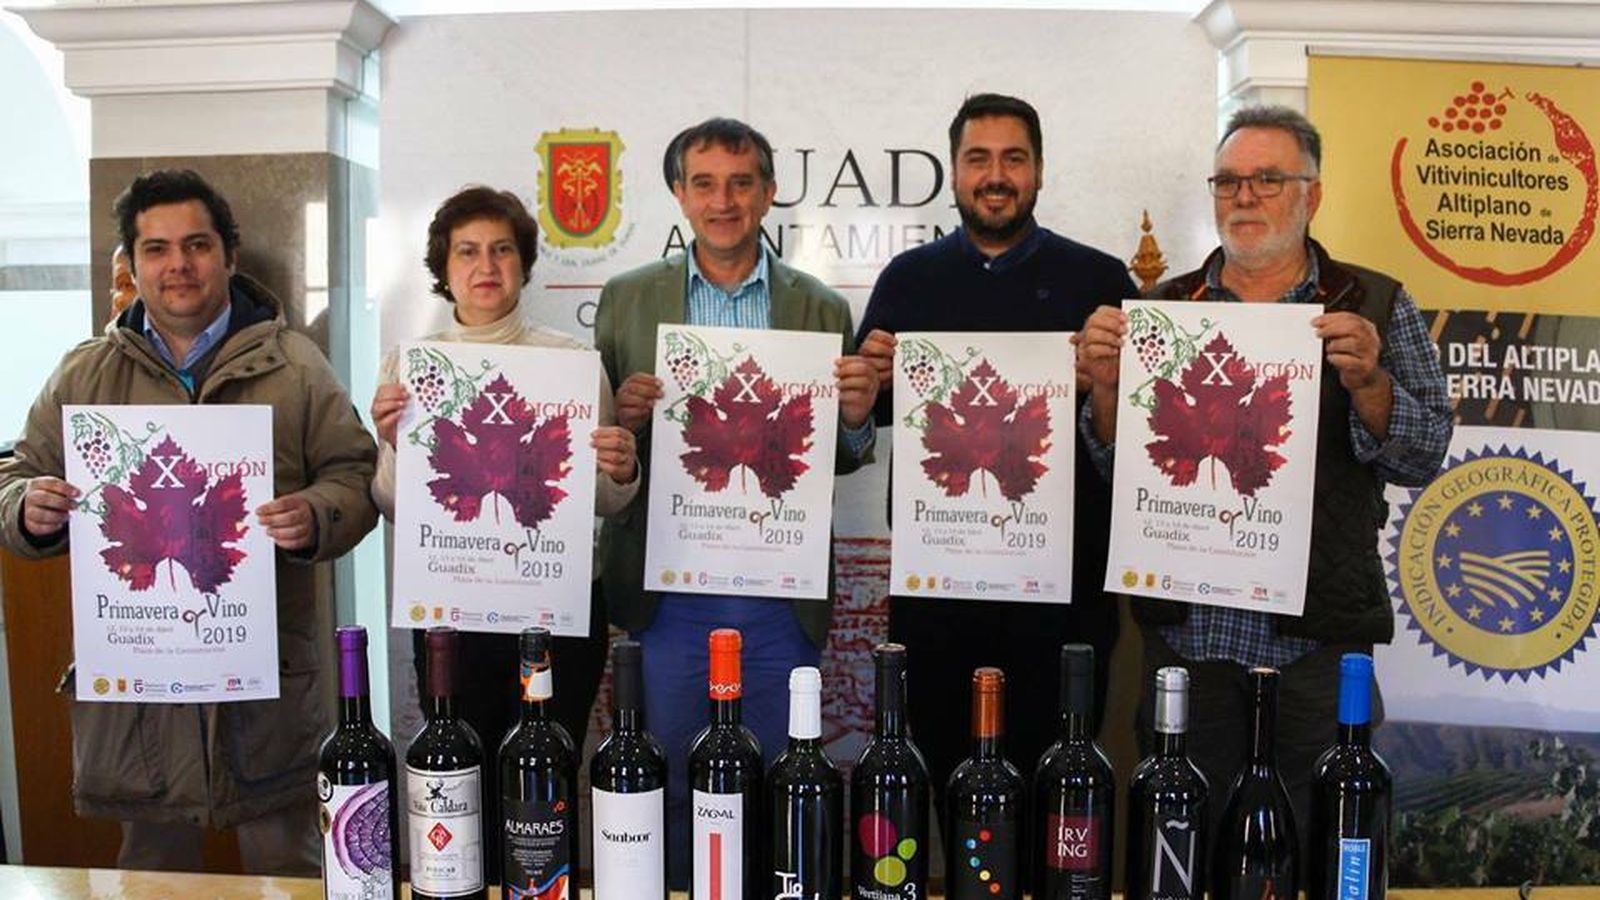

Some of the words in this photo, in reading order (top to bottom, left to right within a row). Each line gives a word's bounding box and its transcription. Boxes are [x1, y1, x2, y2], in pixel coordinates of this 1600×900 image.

[1424, 138, 1541, 163] Asociación
[663, 130, 958, 208] UAD
[1415, 165, 1569, 191] Vitivinicultores
[1437, 192, 1531, 218] Altiplano
[1425, 219, 1485, 241] Sierra
[1491, 222, 1564, 245] Nevada
[1448, 342, 1497, 368] DEL
[1201, 352, 1233, 386] X
[732, 373, 762, 403] X
[968, 376, 998, 406] X
[1447, 373, 1515, 401] ERRA
[481, 392, 515, 425] X
[151, 456, 184, 489] X
[671, 493, 747, 520] Primavera
[770, 499, 806, 522] Vino
[914, 500, 988, 524] Primavera
[1011, 502, 1048, 525] Vino
[1136, 488, 1216, 519] Primavera
[1242, 497, 1283, 524] Vino
[419, 524, 500, 551] Primavera
[526, 529, 565, 554] Vino
[678, 529, 723, 542] Guadix
[765, 528, 804, 545] 2019
[922, 534, 966, 546] Guadix
[1007, 532, 1046, 549] 2019
[1142, 527, 1190, 542] Guadix
[1235, 530, 1280, 551] 2019
[1409, 498, 1447, 627] INDICACIÓN
[1440, 465, 1571, 513] GEOGRÁFICA
[1561, 512, 1596, 633] PROTEGIDA
[428, 561, 476, 575] Guadix
[521, 560, 563, 579] 2019
[96, 594, 179, 620] Primavera
[205, 594, 248, 618] Vino
[107, 632, 155, 645] Guadix
[202, 625, 247, 645] 2019
[504, 818, 565, 836] ALMARAES
[1058, 827, 1088, 840] IRV
[1058, 843, 1088, 858] ING
[1152, 818, 1196, 895] Ñ
[903, 882, 917, 900] 3
